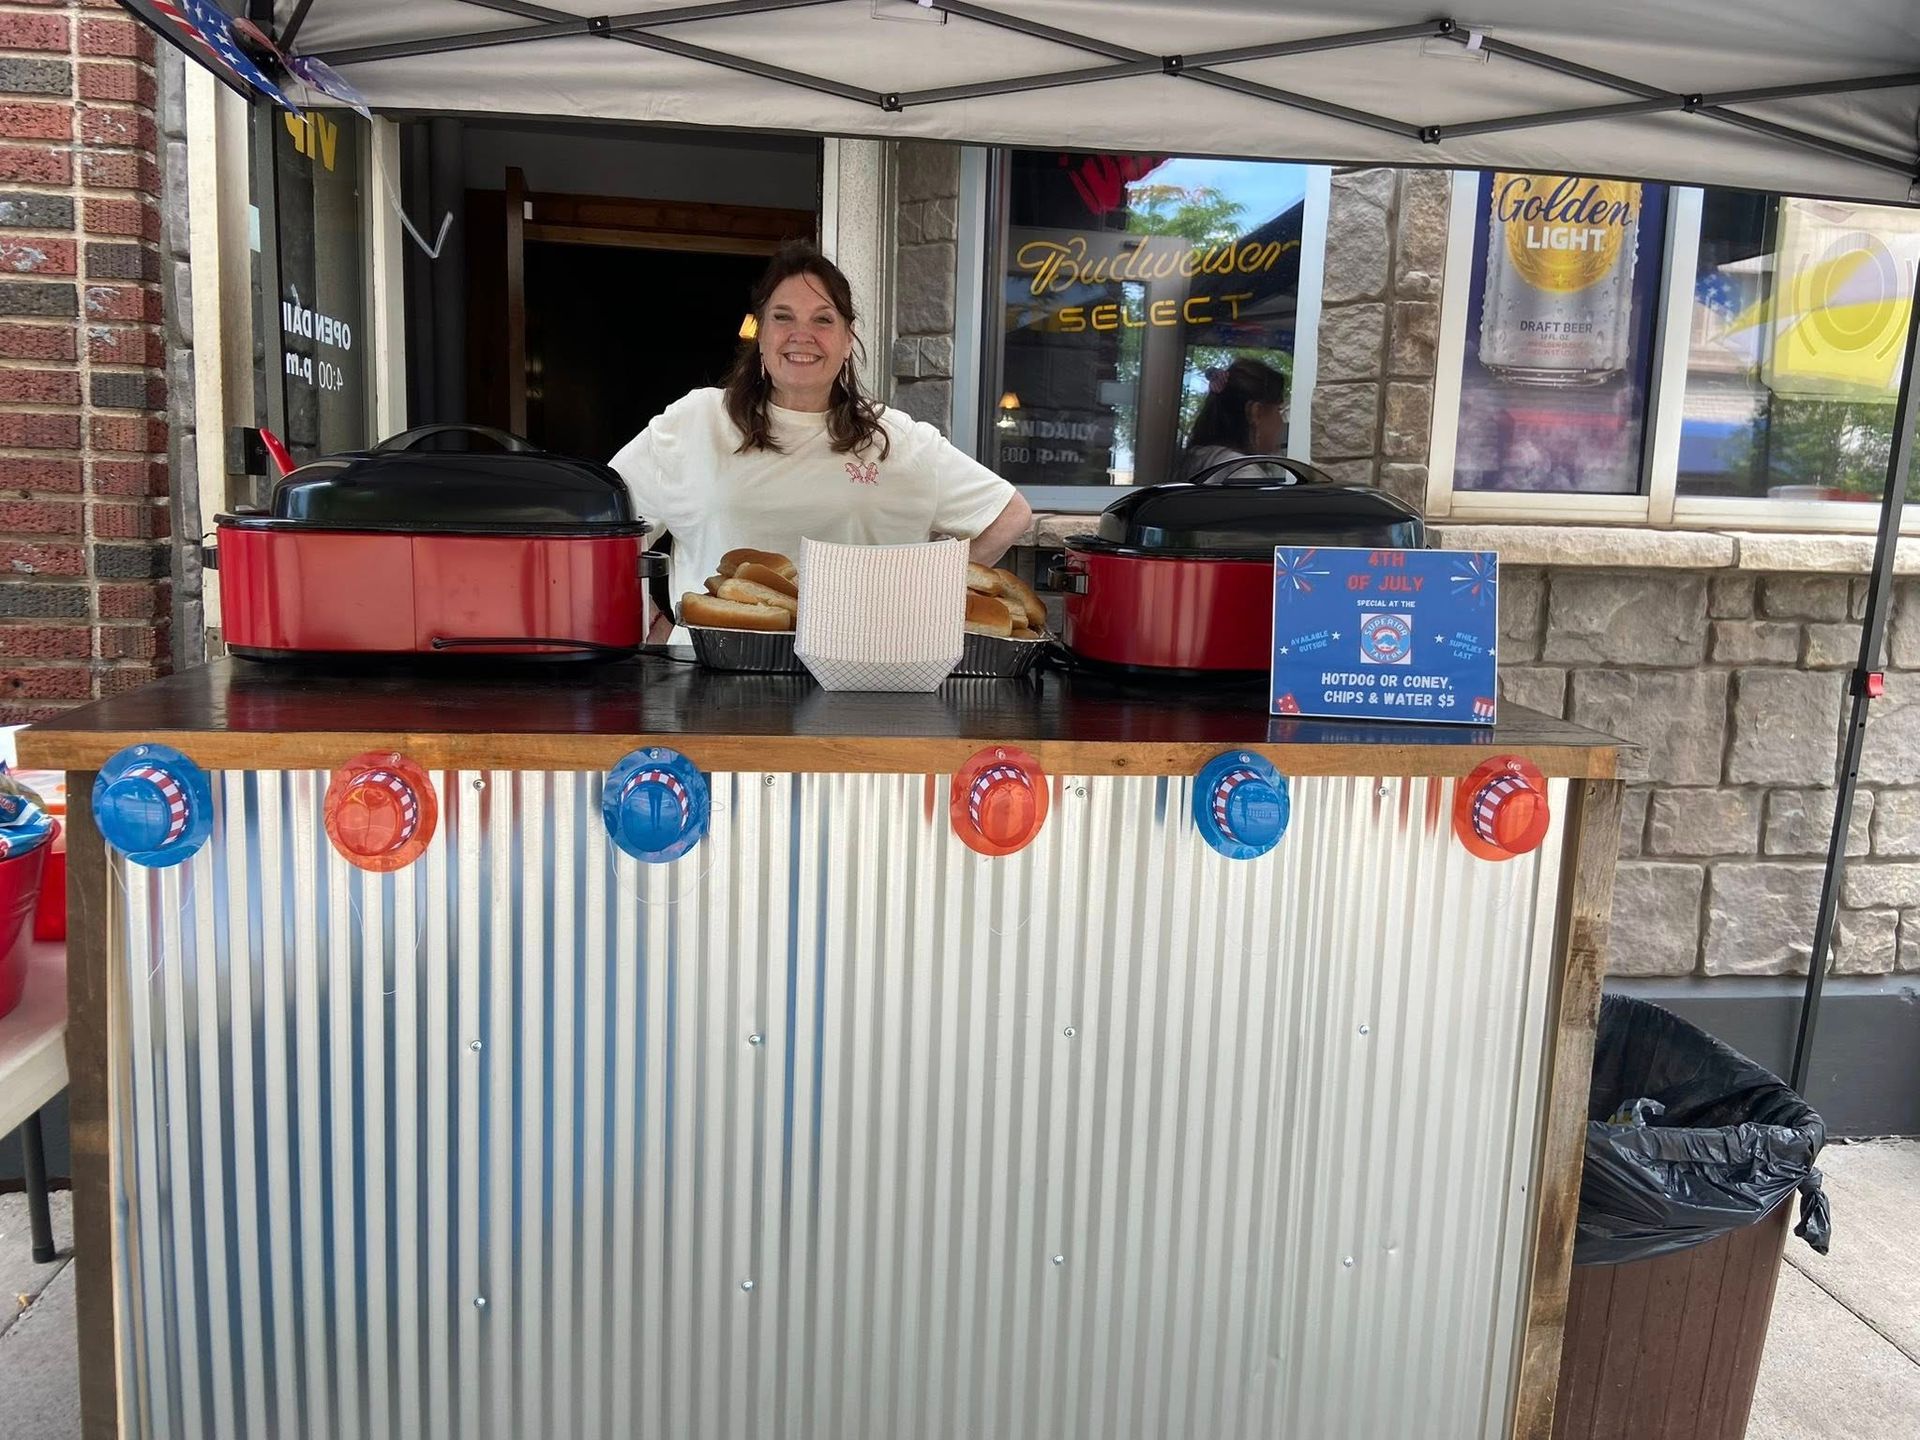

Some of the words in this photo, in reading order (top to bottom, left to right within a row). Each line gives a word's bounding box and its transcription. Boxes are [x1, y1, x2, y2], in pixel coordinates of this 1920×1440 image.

[1498, 176, 1633, 226] Golden
[1526, 226, 1607, 252] LIGHT
[1016, 235, 1301, 296] Budweiser
[1058, 292, 1253, 333] SELECT
[1520, 320, 1560, 332] DRAFT
[1563, 322, 1593, 334] BEER
[1368, 552, 1405, 567] 4TH
[1347, 574, 1370, 591] OF
[1378, 575, 1424, 592] JULY
[1364, 618, 1408, 636] SUPERIOR
[1321, 672, 1375, 686] HOTDOG
[1380, 674, 1398, 687] OR
[1403, 675, 1453, 690] CONEY,
[1323, 690, 1364, 704] CHIPS
[1369, 692, 1378, 704] &
[1383, 692, 1432, 706] WATER
[1437, 693, 1455, 708] $5
